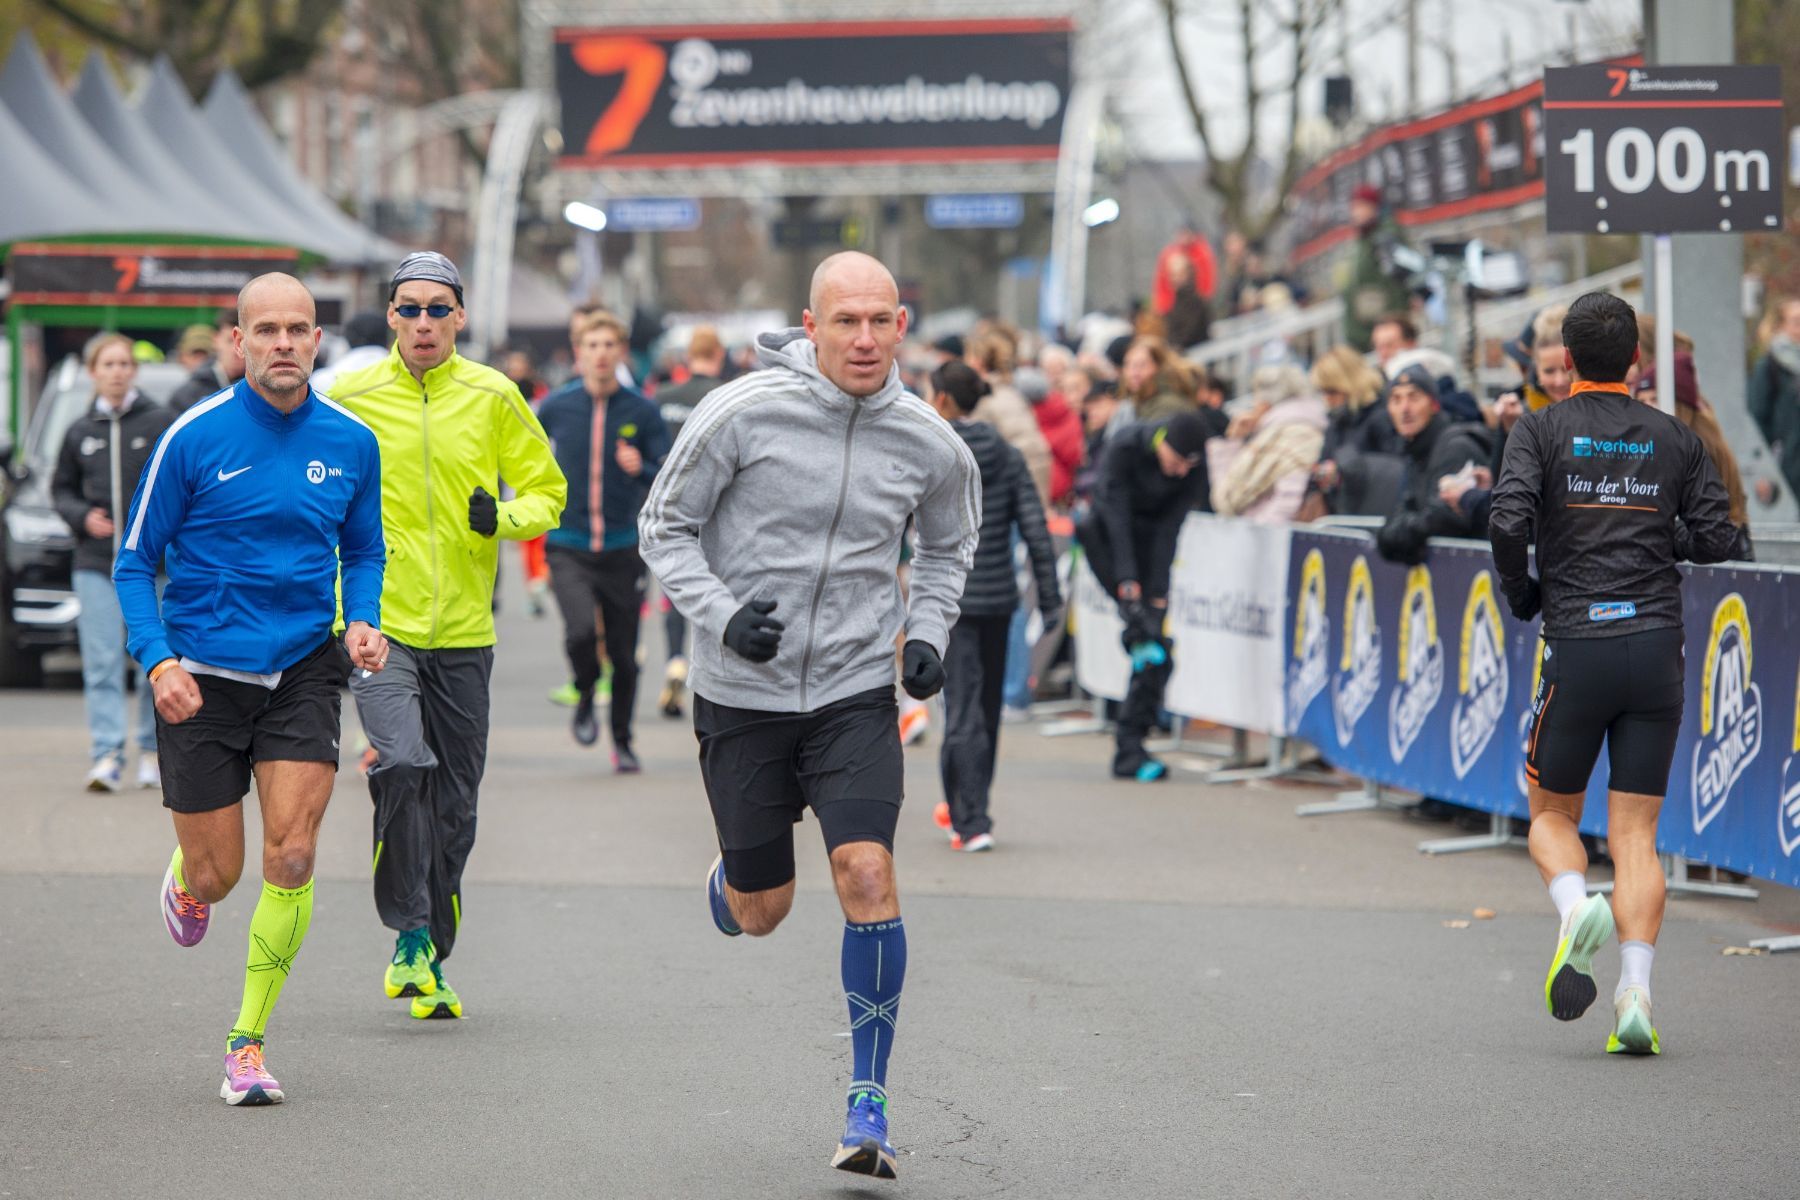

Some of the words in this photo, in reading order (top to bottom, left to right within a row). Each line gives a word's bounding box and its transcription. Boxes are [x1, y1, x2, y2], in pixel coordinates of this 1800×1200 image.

[1606, 68, 1629, 98] 7
[571, 36, 668, 157] 7
[1593, 439, 1654, 455] verheul
[328, 467, 342, 477] NN
[1566, 474, 1592, 493] Van
[1596, 475, 1620, 494] der
[1624, 476, 1660, 497] Voort
[1600, 495, 1627, 505] Groep
[1715, 644, 1744, 742] AA
[1709, 714, 1747, 798] DRINK
